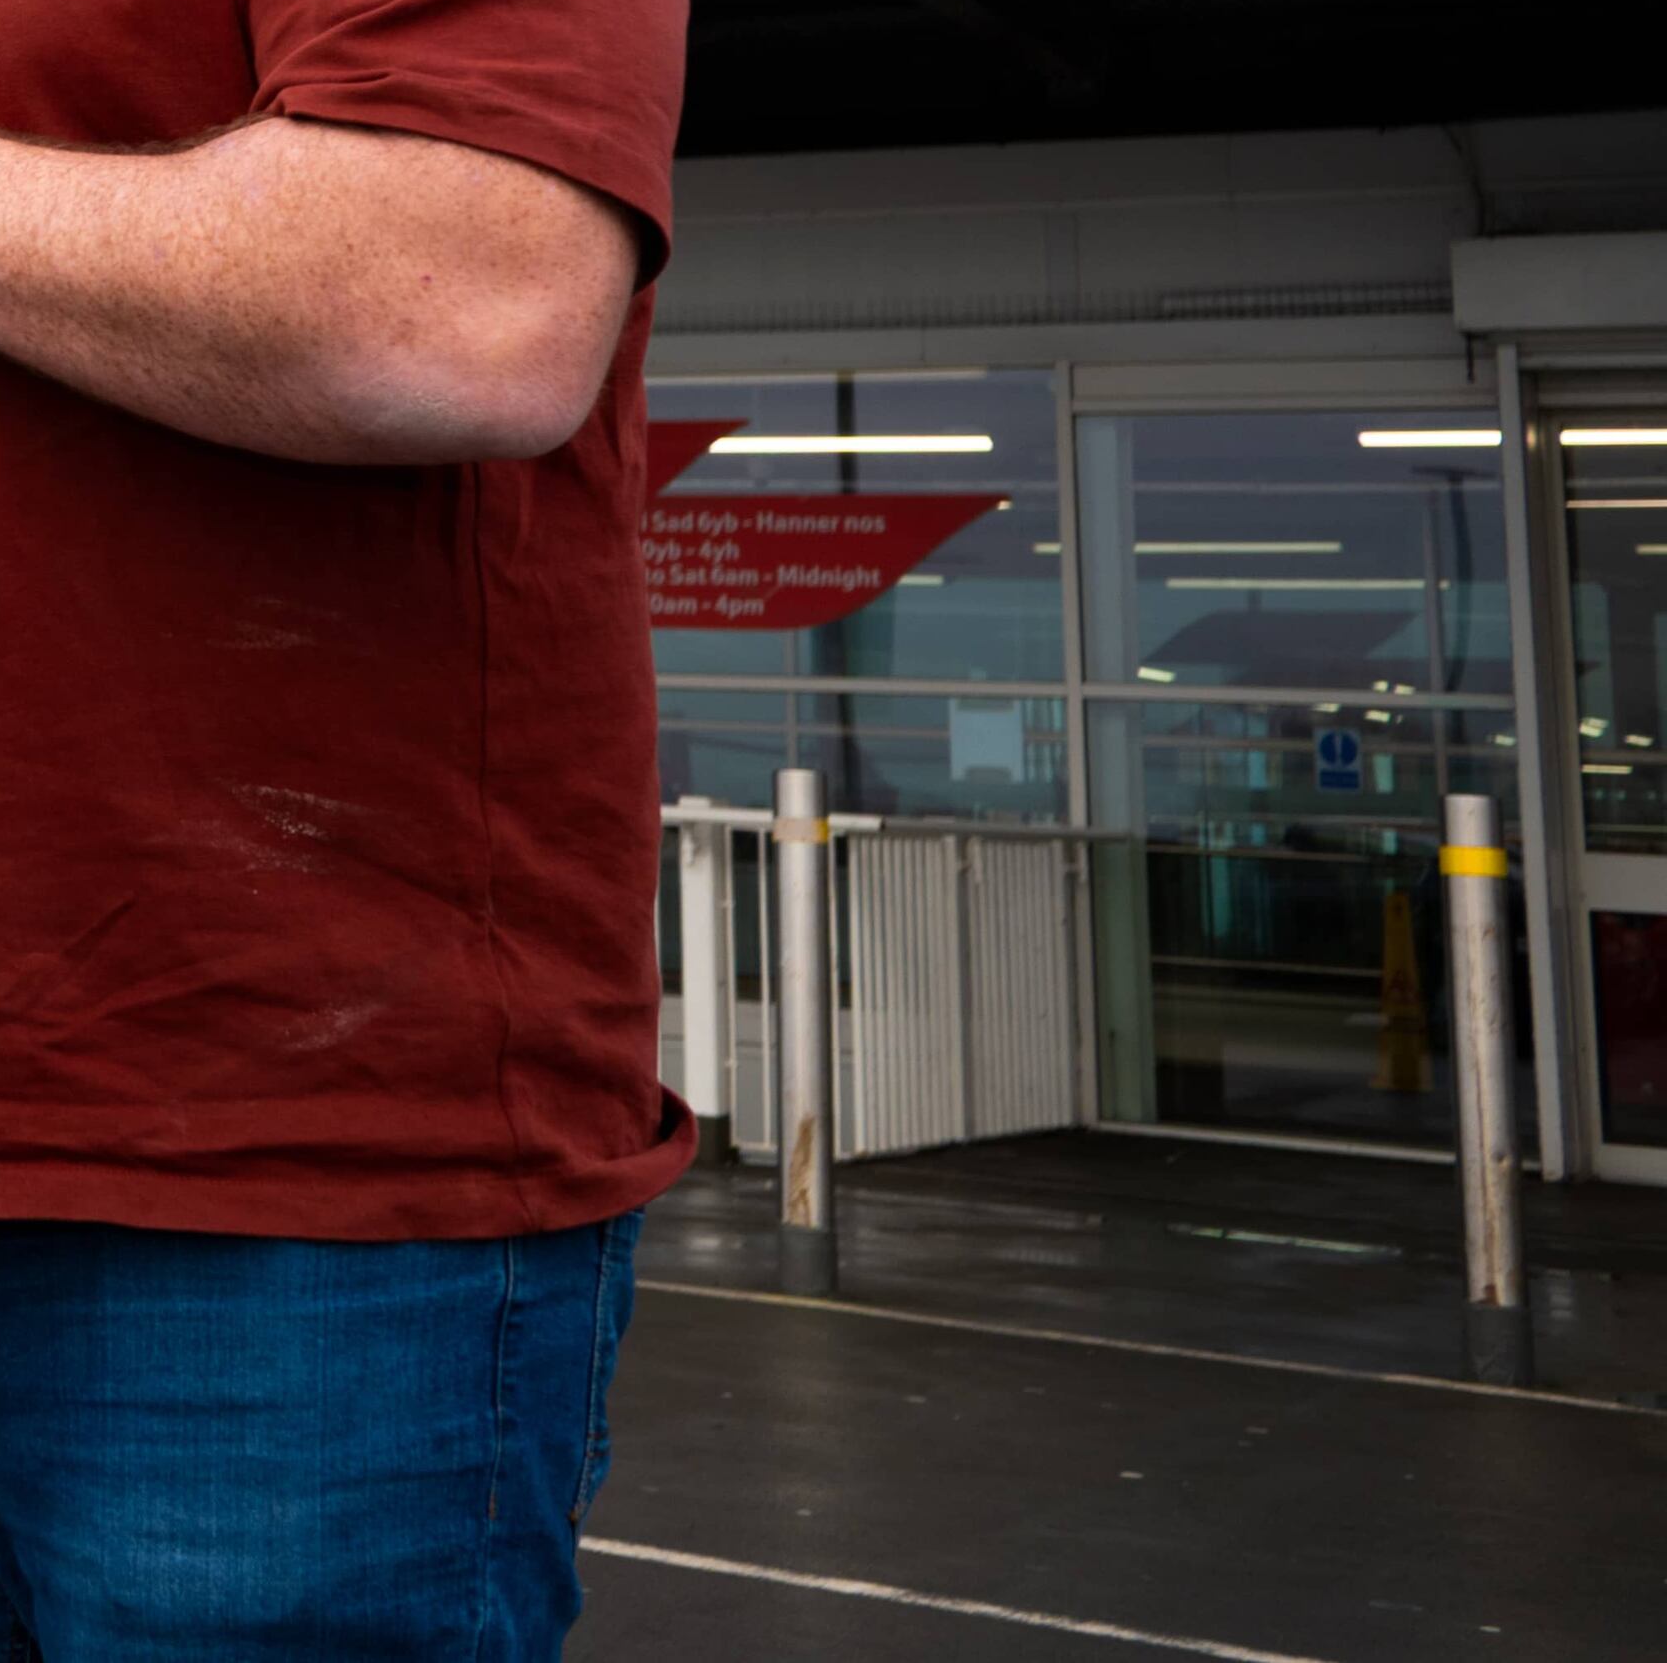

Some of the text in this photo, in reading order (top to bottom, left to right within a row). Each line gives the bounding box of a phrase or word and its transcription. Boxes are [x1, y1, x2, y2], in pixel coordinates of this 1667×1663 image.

[652, 510, 693, 532] Sad
[698, 511, 738, 536] 6yb
[756, 510, 838, 533] Hanner
[843, 515, 887, 533] nos
[698, 539, 740, 563] 4yh
[670, 564, 706, 586] Sat
[710, 565, 759, 586] 6am
[776, 565, 881, 592] Midnight
[715, 592, 765, 619] 4pm
